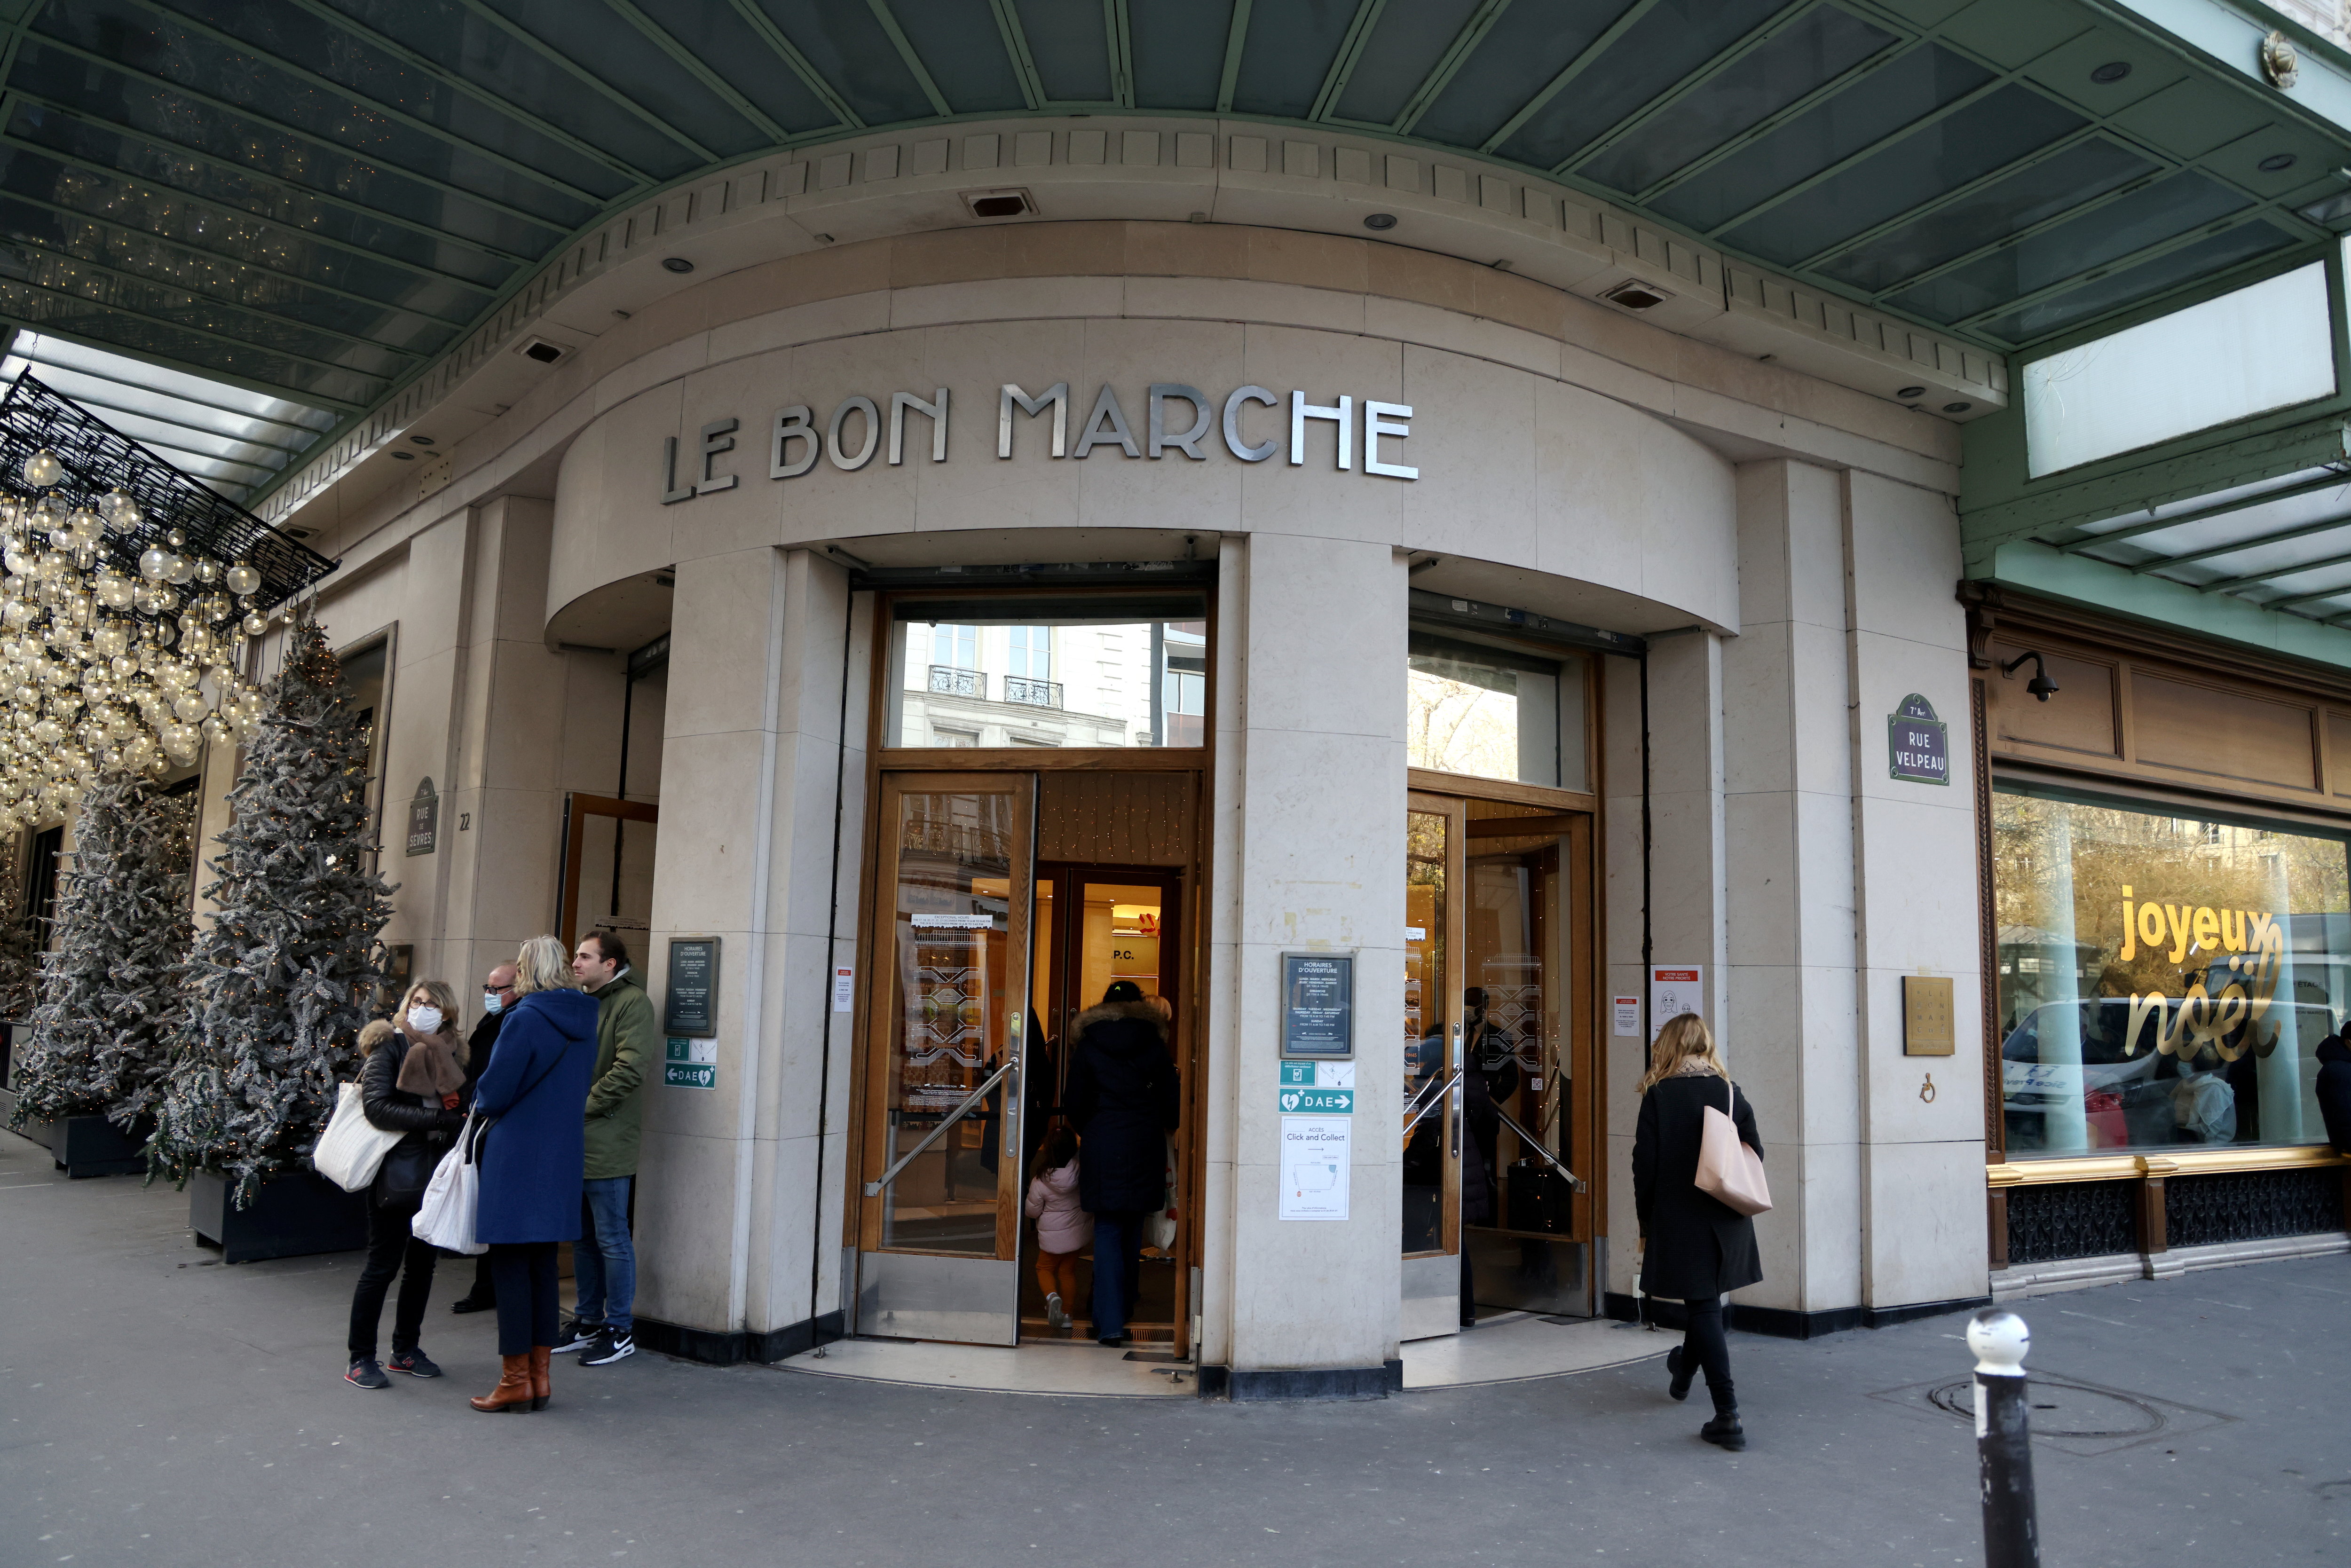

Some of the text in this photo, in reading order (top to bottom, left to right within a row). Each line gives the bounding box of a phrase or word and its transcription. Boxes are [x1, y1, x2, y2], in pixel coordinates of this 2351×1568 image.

[660, 382, 1419, 505] LE BON MARCHE
[1909, 732, 1930, 748] RUE
[1896, 751, 1944, 771] VELPEAU
[417, 806, 429, 820] RUE
[459, 812, 470, 831] 22
[410, 832, 432, 847] SÈVRES
[2121, 885, 2272, 964] joyeux
[2125, 923, 2283, 1062] noël
[678, 1071, 697, 1081] DAE
[1305, 1096, 1333, 1107] DAE
